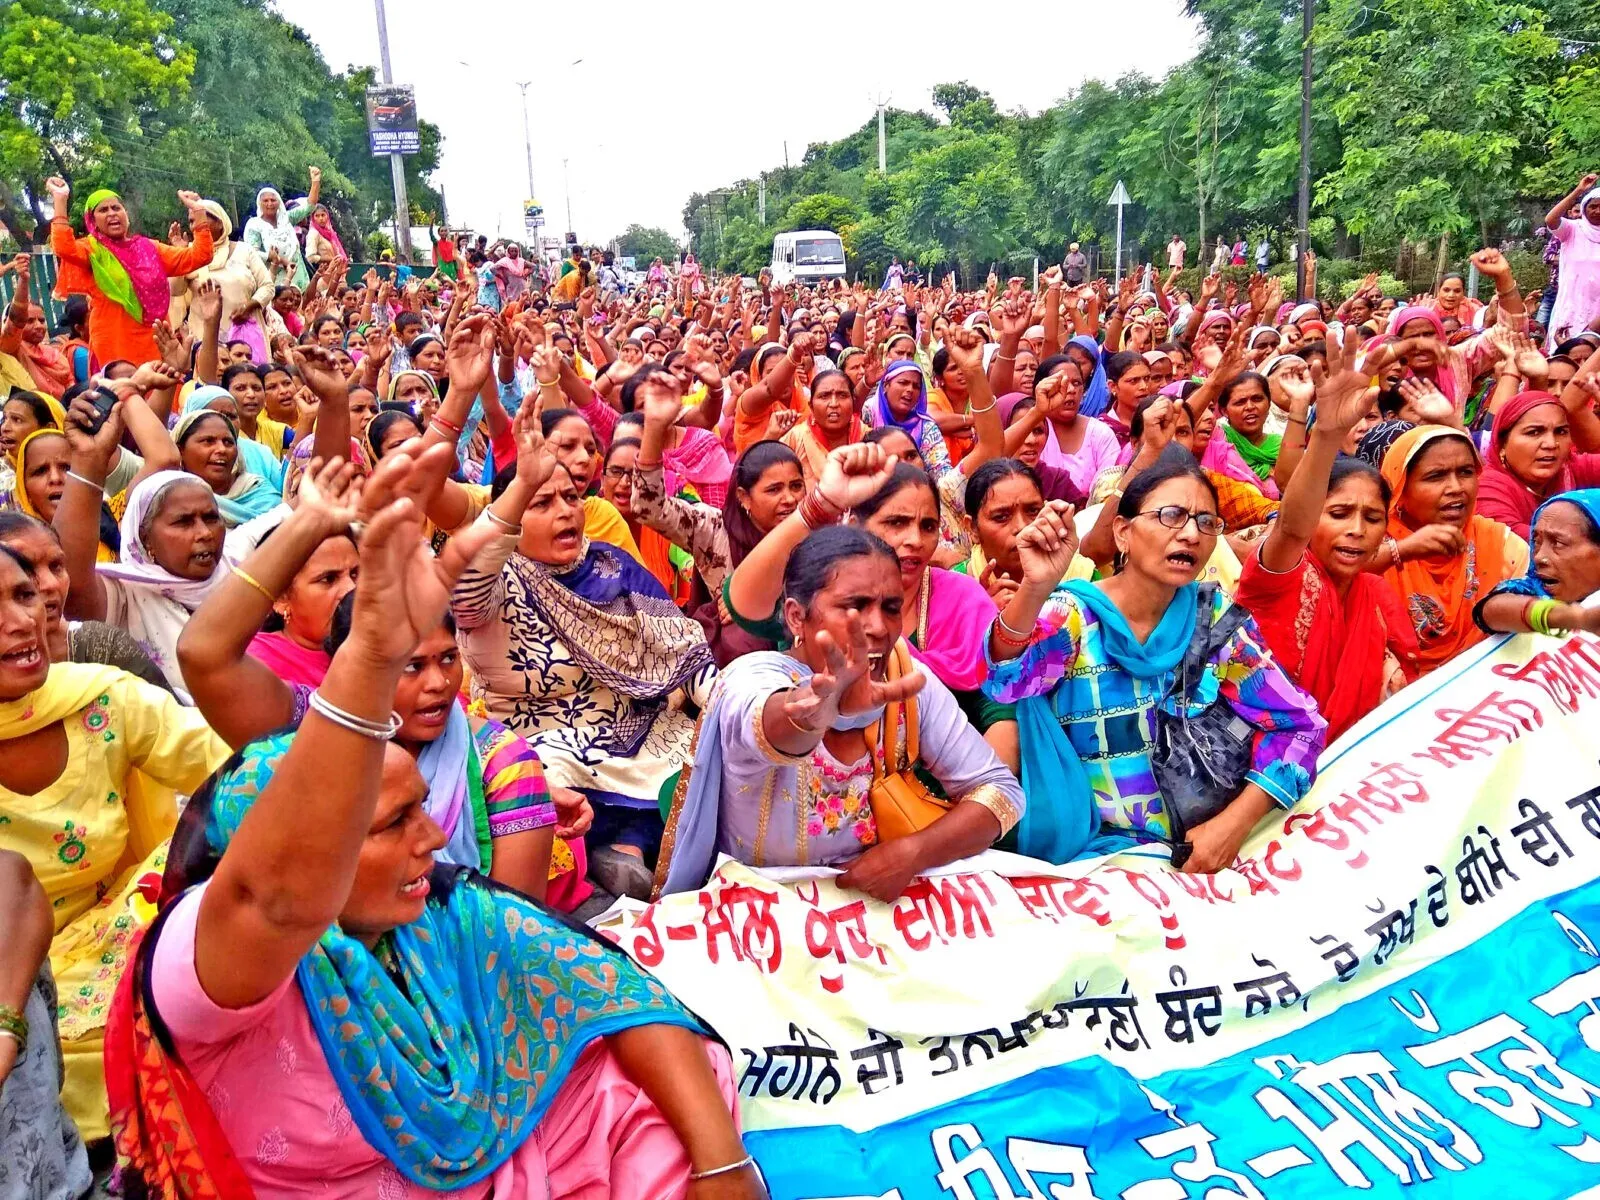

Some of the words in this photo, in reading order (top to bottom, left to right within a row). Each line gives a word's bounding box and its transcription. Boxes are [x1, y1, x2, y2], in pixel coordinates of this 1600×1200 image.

[398, 131, 418, 140] HYUNDAI
[738, 1022, 842, 1105] ਮਹੀਨੇ
[850, 1027, 904, 1096] ਦੀ
[1155, 964, 1223, 1044] ਬੰਦ
[1309, 934, 1360, 983] ਦੋ
[1424, 864, 1450, 928] ਦੇ
[1455, 825, 1521, 906] ਬੀਮੇ
[1510, 798, 1575, 868] ਦੀ
